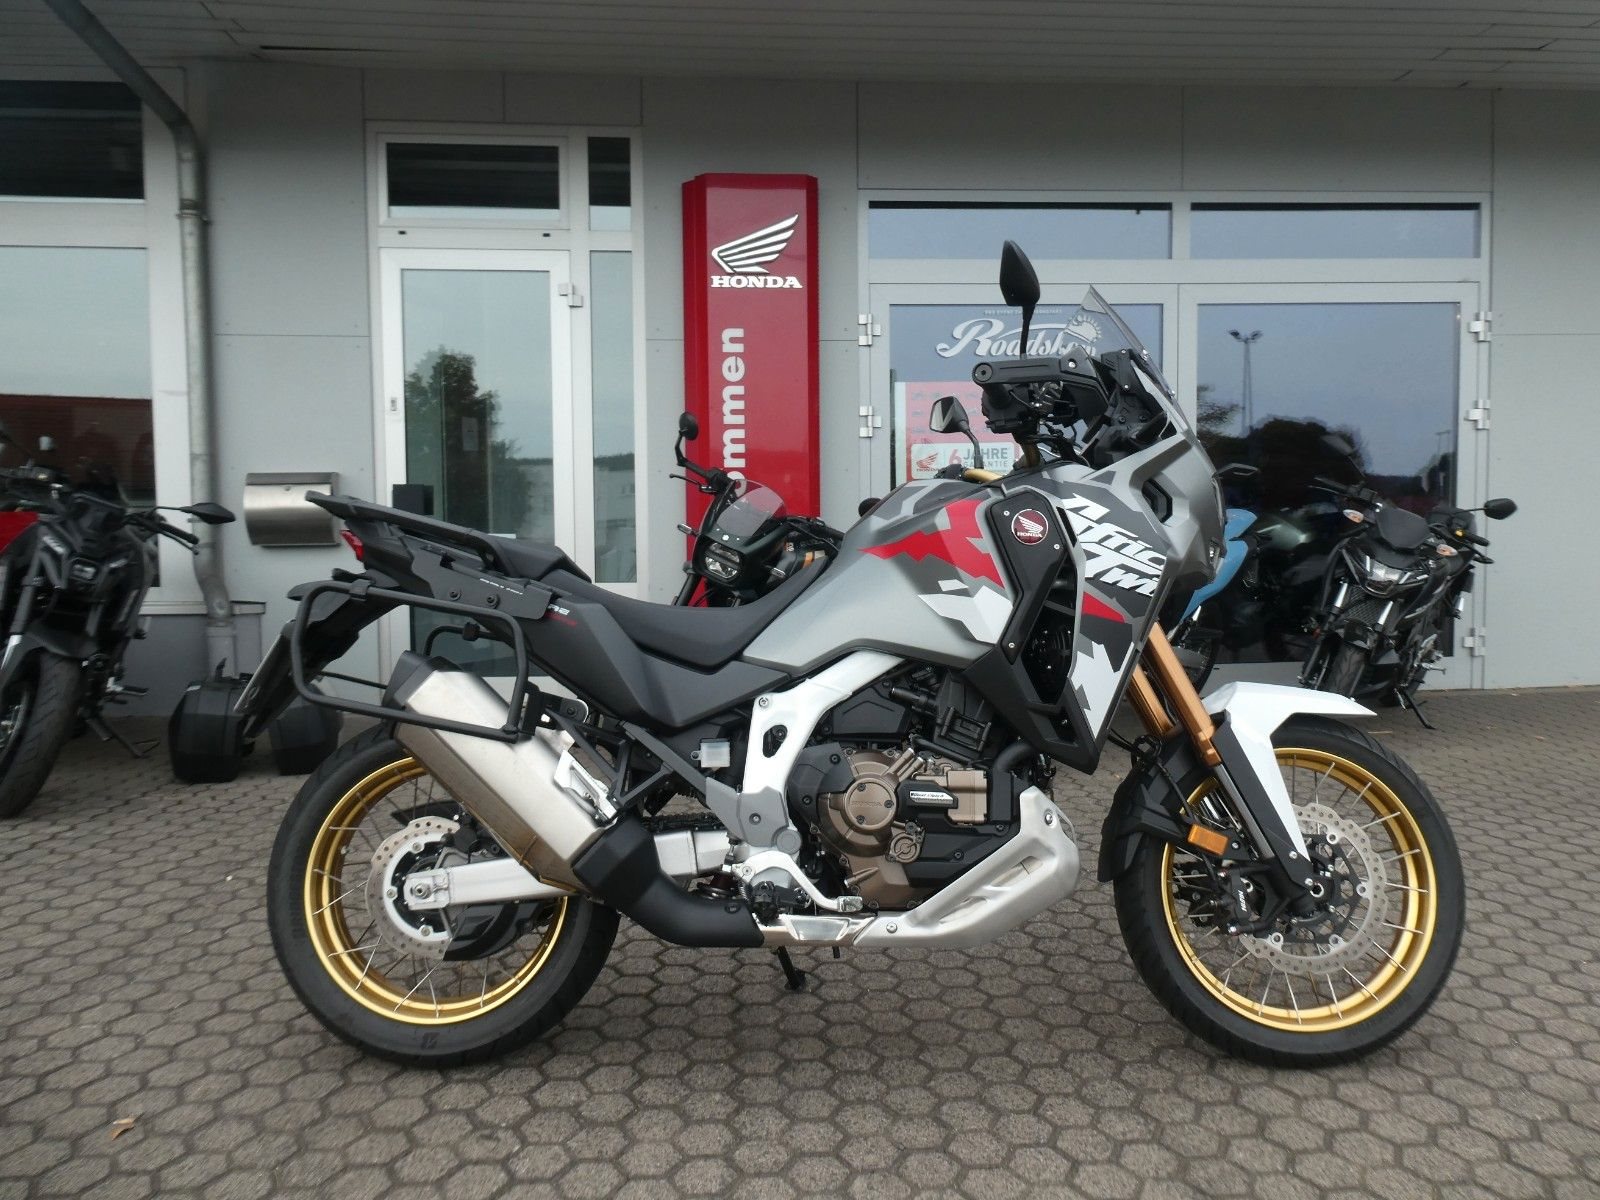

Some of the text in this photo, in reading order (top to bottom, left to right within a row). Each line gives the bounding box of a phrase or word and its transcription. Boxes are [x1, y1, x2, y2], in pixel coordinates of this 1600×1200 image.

[710, 275, 803, 289] HONDA
[949, 447, 1008, 466] 6 JHRE
